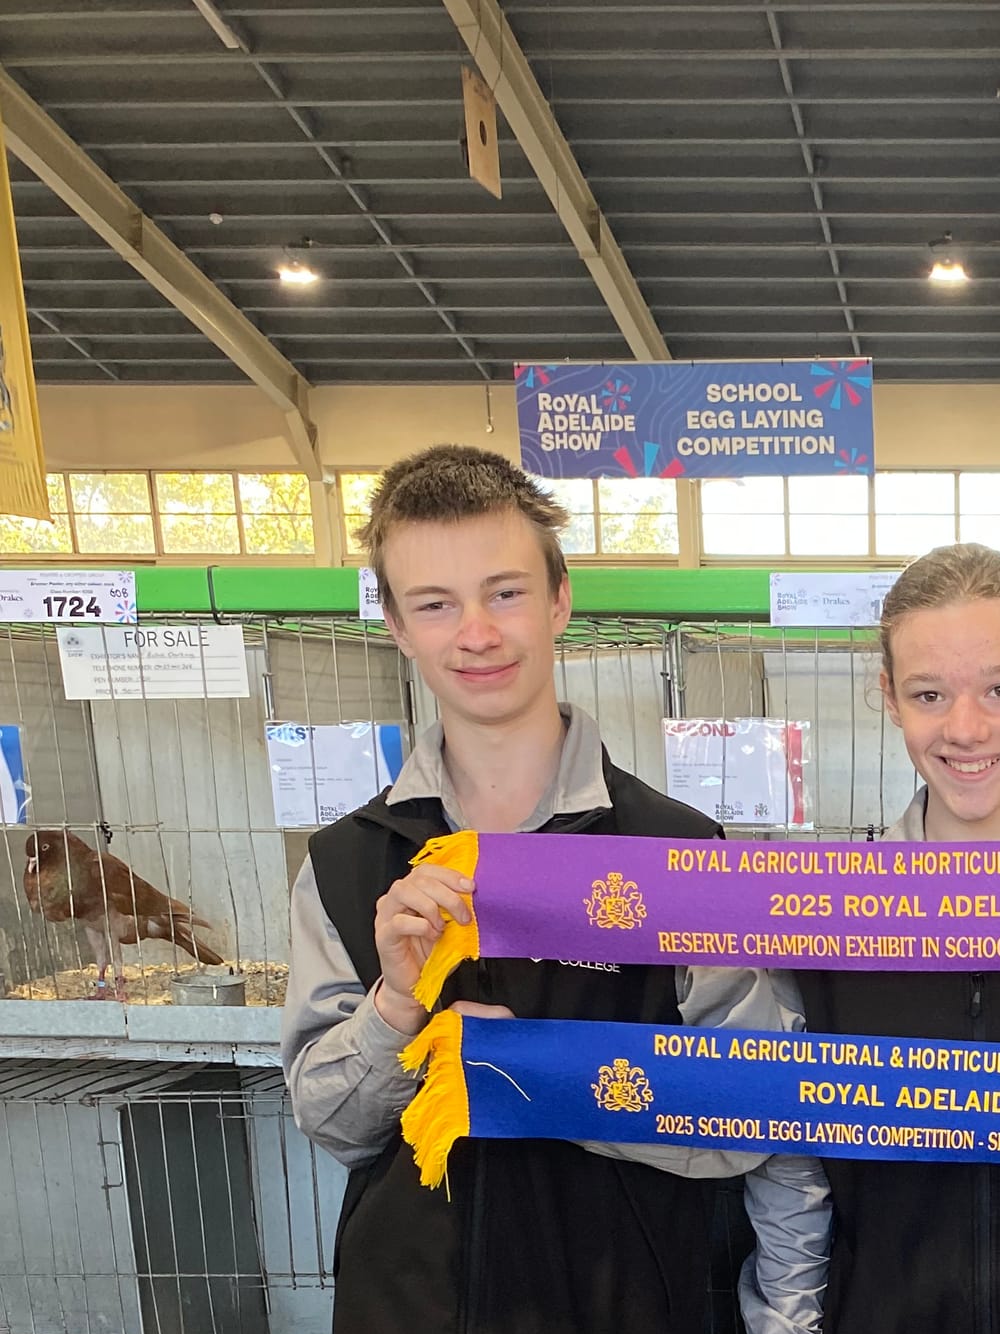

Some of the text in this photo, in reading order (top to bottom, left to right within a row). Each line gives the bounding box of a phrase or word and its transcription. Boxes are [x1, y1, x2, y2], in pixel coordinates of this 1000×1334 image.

[707, 384, 801, 402] SCHOOL
[538, 393, 602, 415] ROYAL
[538, 411, 635, 432] ADELAIDE
[687, 409, 823, 429] EGG LAYING
[541, 432, 601, 451] SHOW
[677, 436, 834, 455] COMPETITION
[109, 587, 129, 598] 608
[823, 597, 850, 605] Drakes
[43, 596, 102, 617] 1724
[124, 630, 210, 648] FOR SALE
[666, 847, 732, 874] ROYAL
[737, 849, 889, 876] AGRICULTURAL
[892, 851, 908, 876] &
[769, 892, 833, 918] 2025
[843, 893, 927, 919] ROYAL
[657, 930, 738, 955] RESERVE
[742, 933, 841, 957] CHAMPION
[845, 934, 916, 958] EXHIBIT
[921, 936, 940, 959] IN
[654, 1034, 721, 1058] ROYAL
[729, 1039, 883, 1067] AGRICULTURAL
[890, 1047, 904, 1068] &
[799, 1081, 883, 1107] ROYAL
[656, 1115, 694, 1135] 2025
[698, 1117, 763, 1139] SCHOOL
[769, 1120, 802, 1140] EGG
[806, 1123, 862, 1144] LAYING
[867, 1127, 974, 1148] COMPETITION
